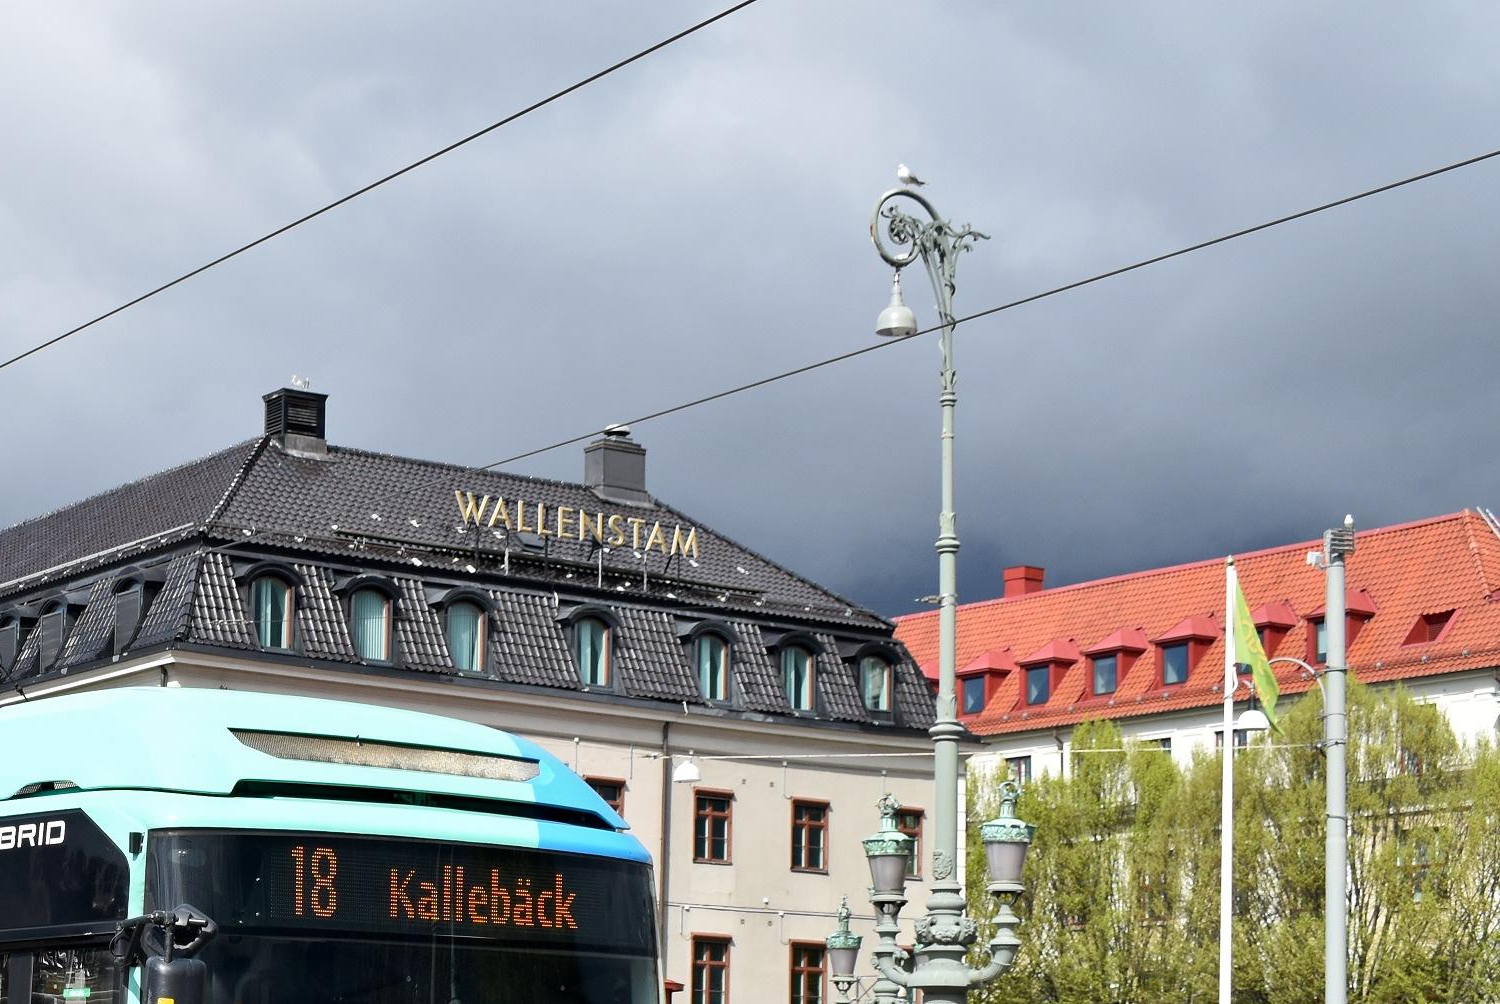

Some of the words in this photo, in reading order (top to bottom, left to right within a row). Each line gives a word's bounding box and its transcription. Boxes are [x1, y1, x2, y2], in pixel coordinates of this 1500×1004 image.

[455, 490, 699, 559] WALLENSTAM
[291, 846, 337, 918] 18
[390, 864, 579, 929] Kallebäck
